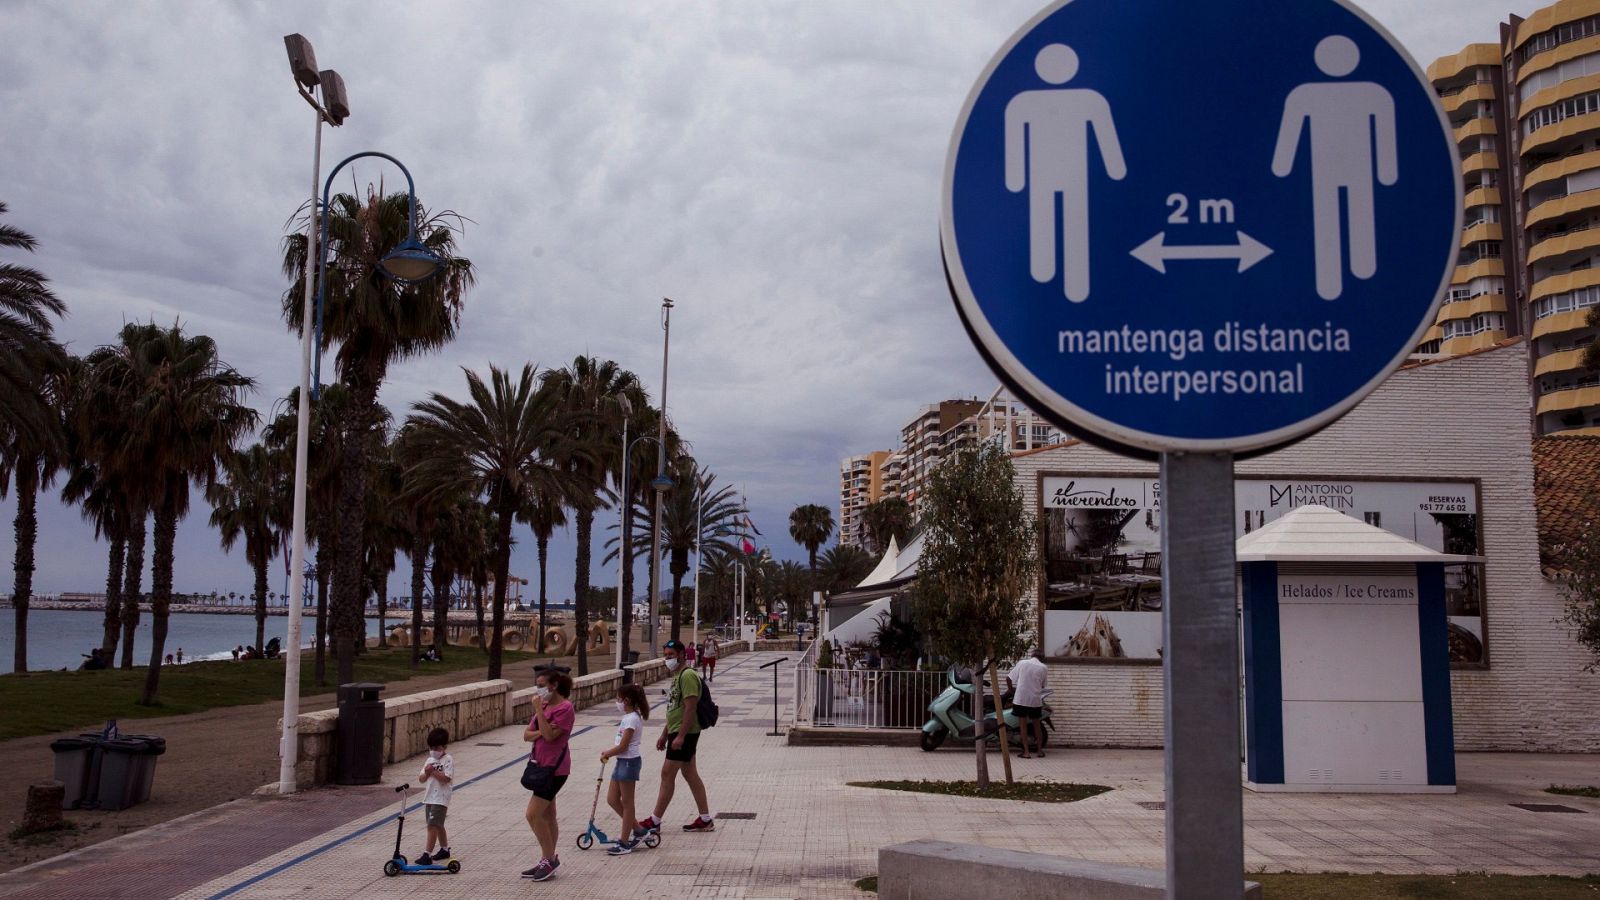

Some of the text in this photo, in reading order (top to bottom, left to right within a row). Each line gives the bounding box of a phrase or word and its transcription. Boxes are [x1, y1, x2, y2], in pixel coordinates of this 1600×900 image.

[1166, 193, 1235, 224] 2 m
[1058, 322, 1350, 360] mantenga distancia
[1105, 363, 1303, 401] interpersonal
[1052, 487, 1136, 506] merendero
[1296, 485, 1353, 494] ANTONIO
[1419, 503, 1432, 511] 951
[1428, 495, 1466, 503] RESERVAS
[1282, 584, 1333, 598] Helados
[1345, 585, 1363, 598] Ice
[1367, 585, 1414, 599] Creams
